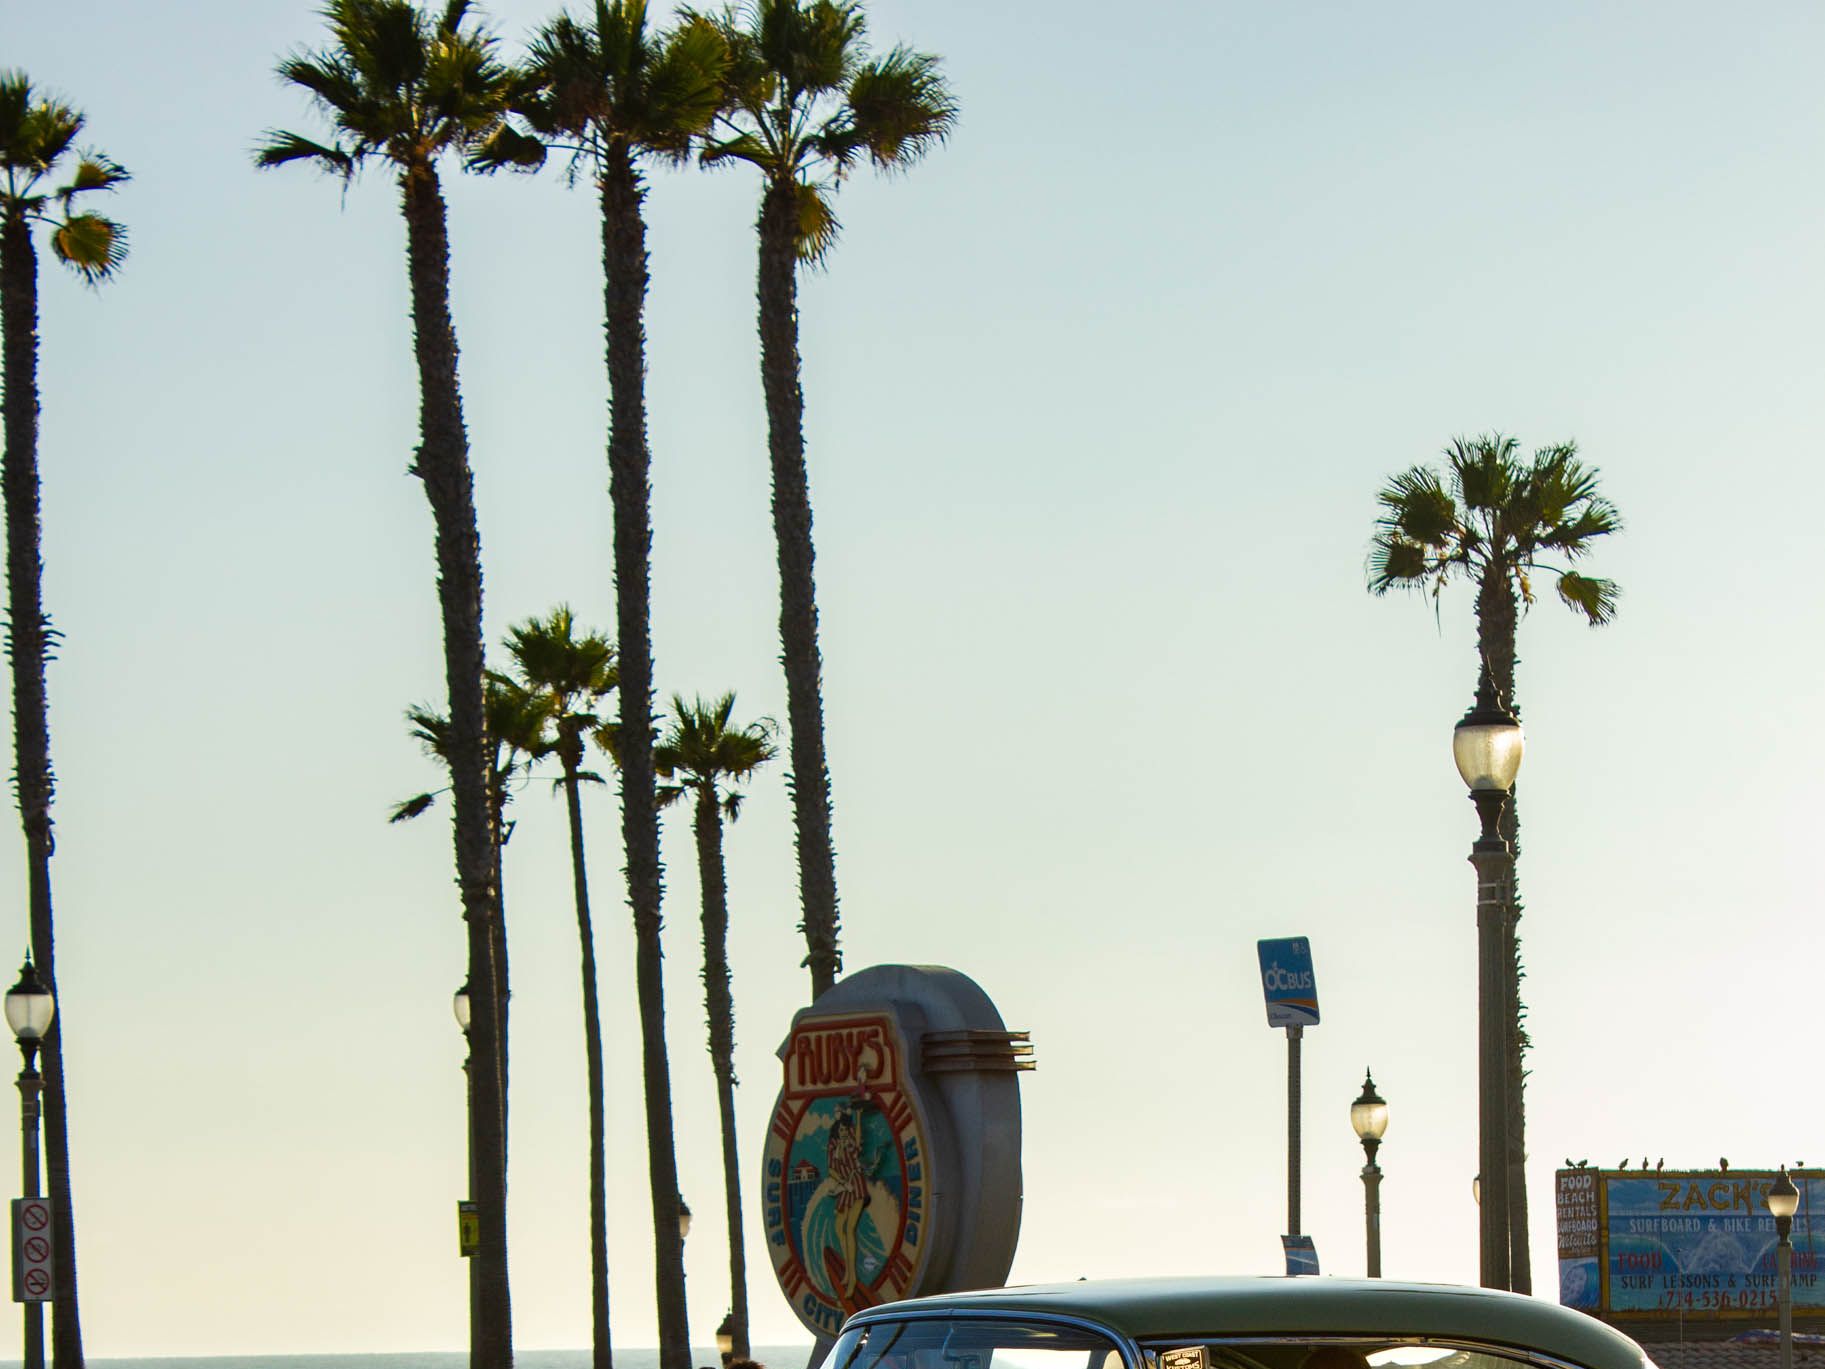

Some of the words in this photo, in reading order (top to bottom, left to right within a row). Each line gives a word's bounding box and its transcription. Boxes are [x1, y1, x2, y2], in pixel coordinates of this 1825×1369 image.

[1560, 1174, 1592, 1191] FOOD
[904, 1136, 922, 1247] DINER
[1557, 1192, 1595, 1204] BEACH
[1658, 1182, 1771, 1215] ZACK'S
[767, 1157, 786, 1247] SURF
[1557, 1205, 1598, 1218] RENTALS
[1629, 1218, 1702, 1233] SURFBOARD
[1707, 1218, 1719, 1233] &
[1724, 1218, 1752, 1233] BIKE
[1758, 1218, 1810, 1233] RENLS
[1617, 1252, 1663, 1271] FOOD
[1762, 1252, 1817, 1270] CARING
[1621, 1275, 1655, 1289] SURF
[1663, 1274, 1719, 1288] LESSONS
[1727, 1274, 1737, 1288] &
[1745, 1274, 1777, 1288] SURF
[1790, 1273, 1817, 1288] AMP
[802, 1294, 843, 1332] CITY
[1165, 1353, 1181, 1362] WEST
[1182, 1350, 1199, 1358] COAST
